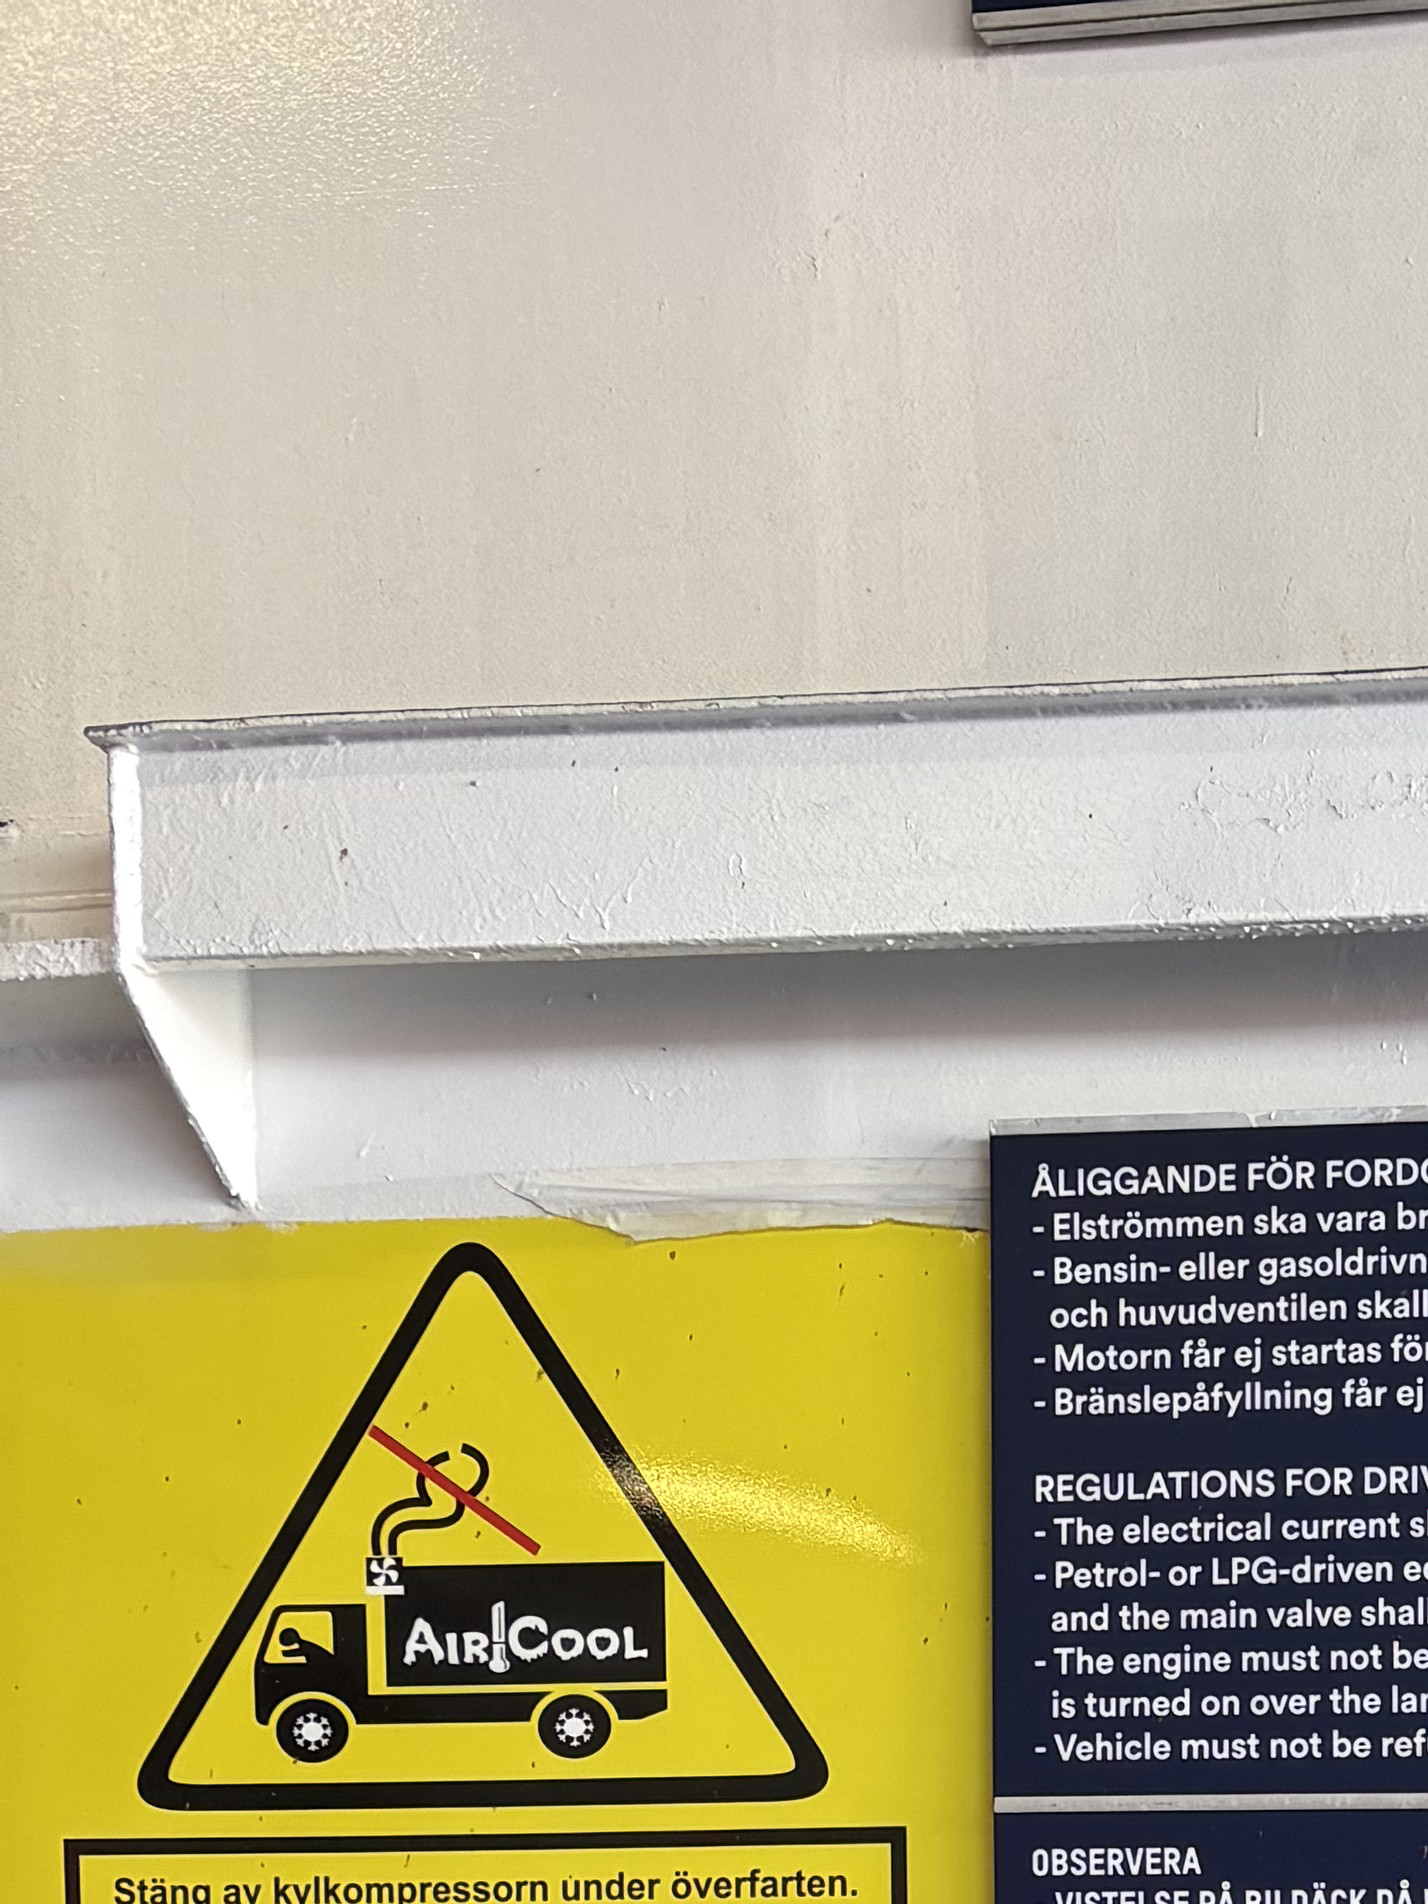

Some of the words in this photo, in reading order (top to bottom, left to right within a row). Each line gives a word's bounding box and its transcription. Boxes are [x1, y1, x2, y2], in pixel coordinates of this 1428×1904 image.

[1031, 1162, 1237, 1198] ÅLIGGANDE
[1247, 1154, 1316, 1191] FÖR
[1053, 1211, 1244, 1241] Elströmmen
[1253, 1205, 1307, 1235] ska
[1316, 1210, 1386, 1233] vara
[1053, 1253, 1171, 1285] Bensin-
[1178, 1251, 1250, 1281] eller
[1049, 1298, 1108, 1329] och
[1118, 1292, 1347, 1327] huvudventilen
[1357, 1288, 1428, 1320] skall
[1054, 1343, 1172, 1372] Motorn
[1180, 1337, 1226, 1369] får
[1234, 1337, 1262, 1374] ej
[1271, 1338, 1382, 1366] startas
[1054, 1380, 1333, 1419] Bränslepåfyllning
[1341, 1377, 1388, 1408] får
[1396, 1376, 1424, 1413] ej
[1035, 1468, 1276, 1503] REGULATIONS
[1285, 1467, 1354, 1497] FOR
[1052, 1516, 1114, 1546] The
[1122, 1511, 1271, 1544] electrical
[1281, 1511, 1401, 1541] current
[1055, 1558, 1161, 1589] Petrol-
[1168, 1565, 1203, 1587] or
[1212, 1553, 1393, 1585] LPG-driven
[1051, 1602, 1109, 1633] and
[1118, 1601, 1171, 1631] the
[1180, 1599, 1257, 1630] main
[1266, 1598, 1352, 1628] valve
[1053, 1646, 1115, 1675] The
[1122, 1643, 1232, 1681] engine
[1241, 1645, 1320, 1672] must
[1330, 1644, 1383, 1671] not
[1051, 1689, 1076, 1719] is
[1084, 1687, 1191, 1718] turned
[1200, 1695, 1240, 1716] on
[1249, 1694, 1322, 1716] over
[1328, 1685, 1382, 1715] the
[1053, 1731, 1172, 1762] Vehicle
[1181, 1733, 1260, 1760] must
[1270, 1732, 1322, 1759] not
[1332, 1729, 1372, 1758] be
[1032, 1846, 1202, 1877] OBSERVERA
[561, 1871, 661, 1902] under
[671, 1868, 858, 1900] överfarten.
